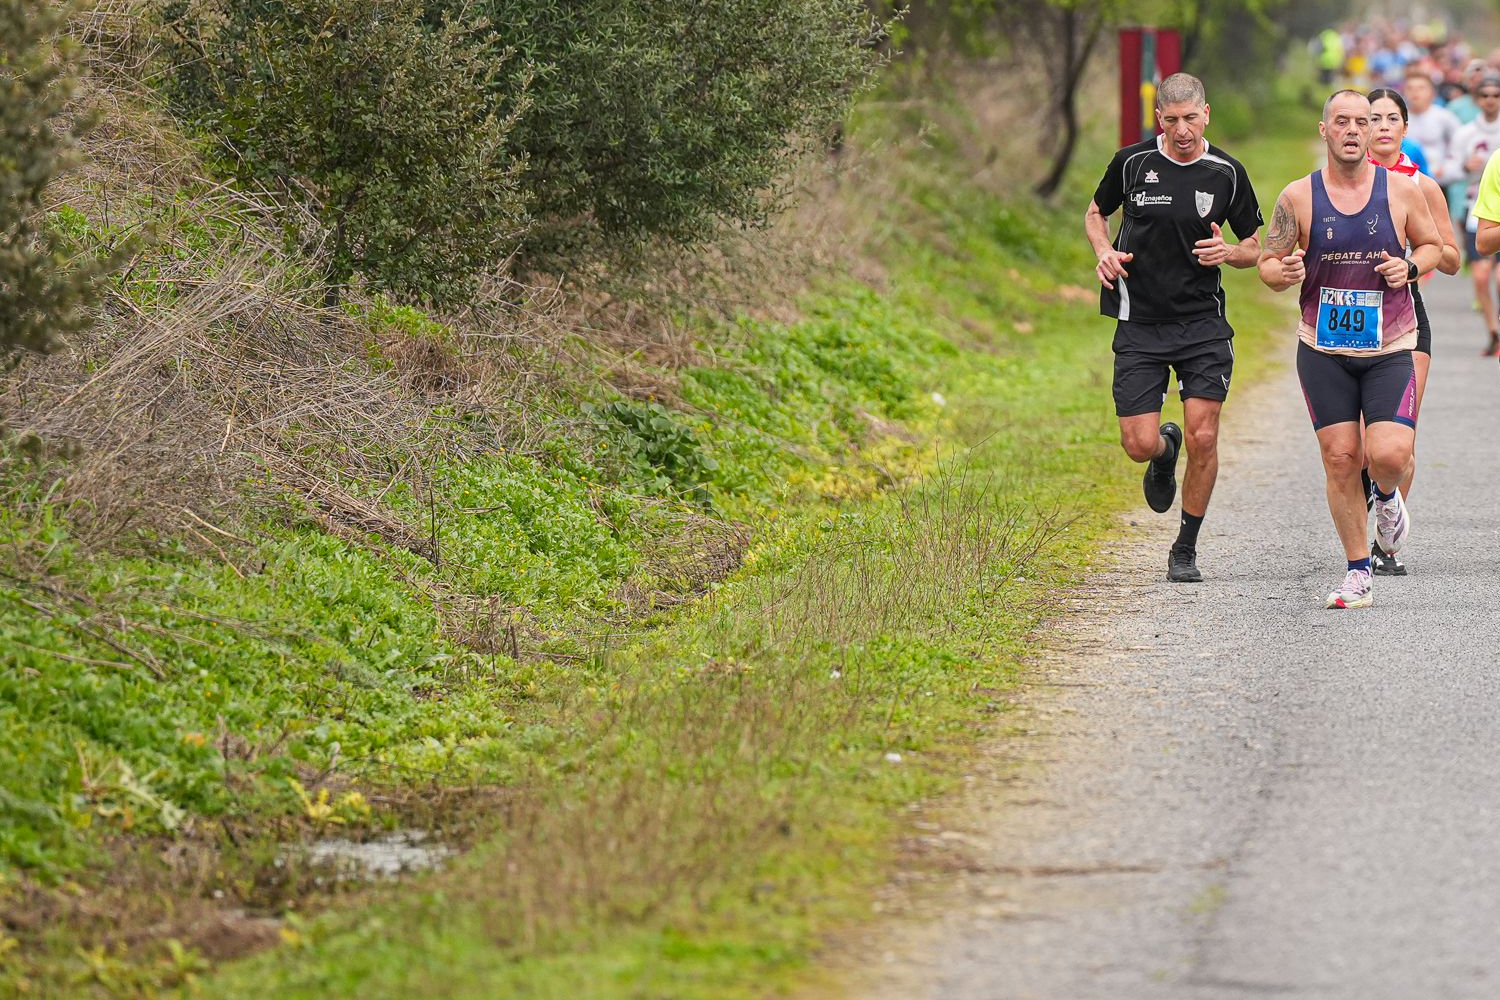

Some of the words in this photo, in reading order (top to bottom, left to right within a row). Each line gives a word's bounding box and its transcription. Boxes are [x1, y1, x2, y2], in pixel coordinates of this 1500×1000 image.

[1321, 250, 1363, 261] PÉGATE
[1327, 289, 1345, 306] 21K
[1328, 308, 1365, 332] 849
